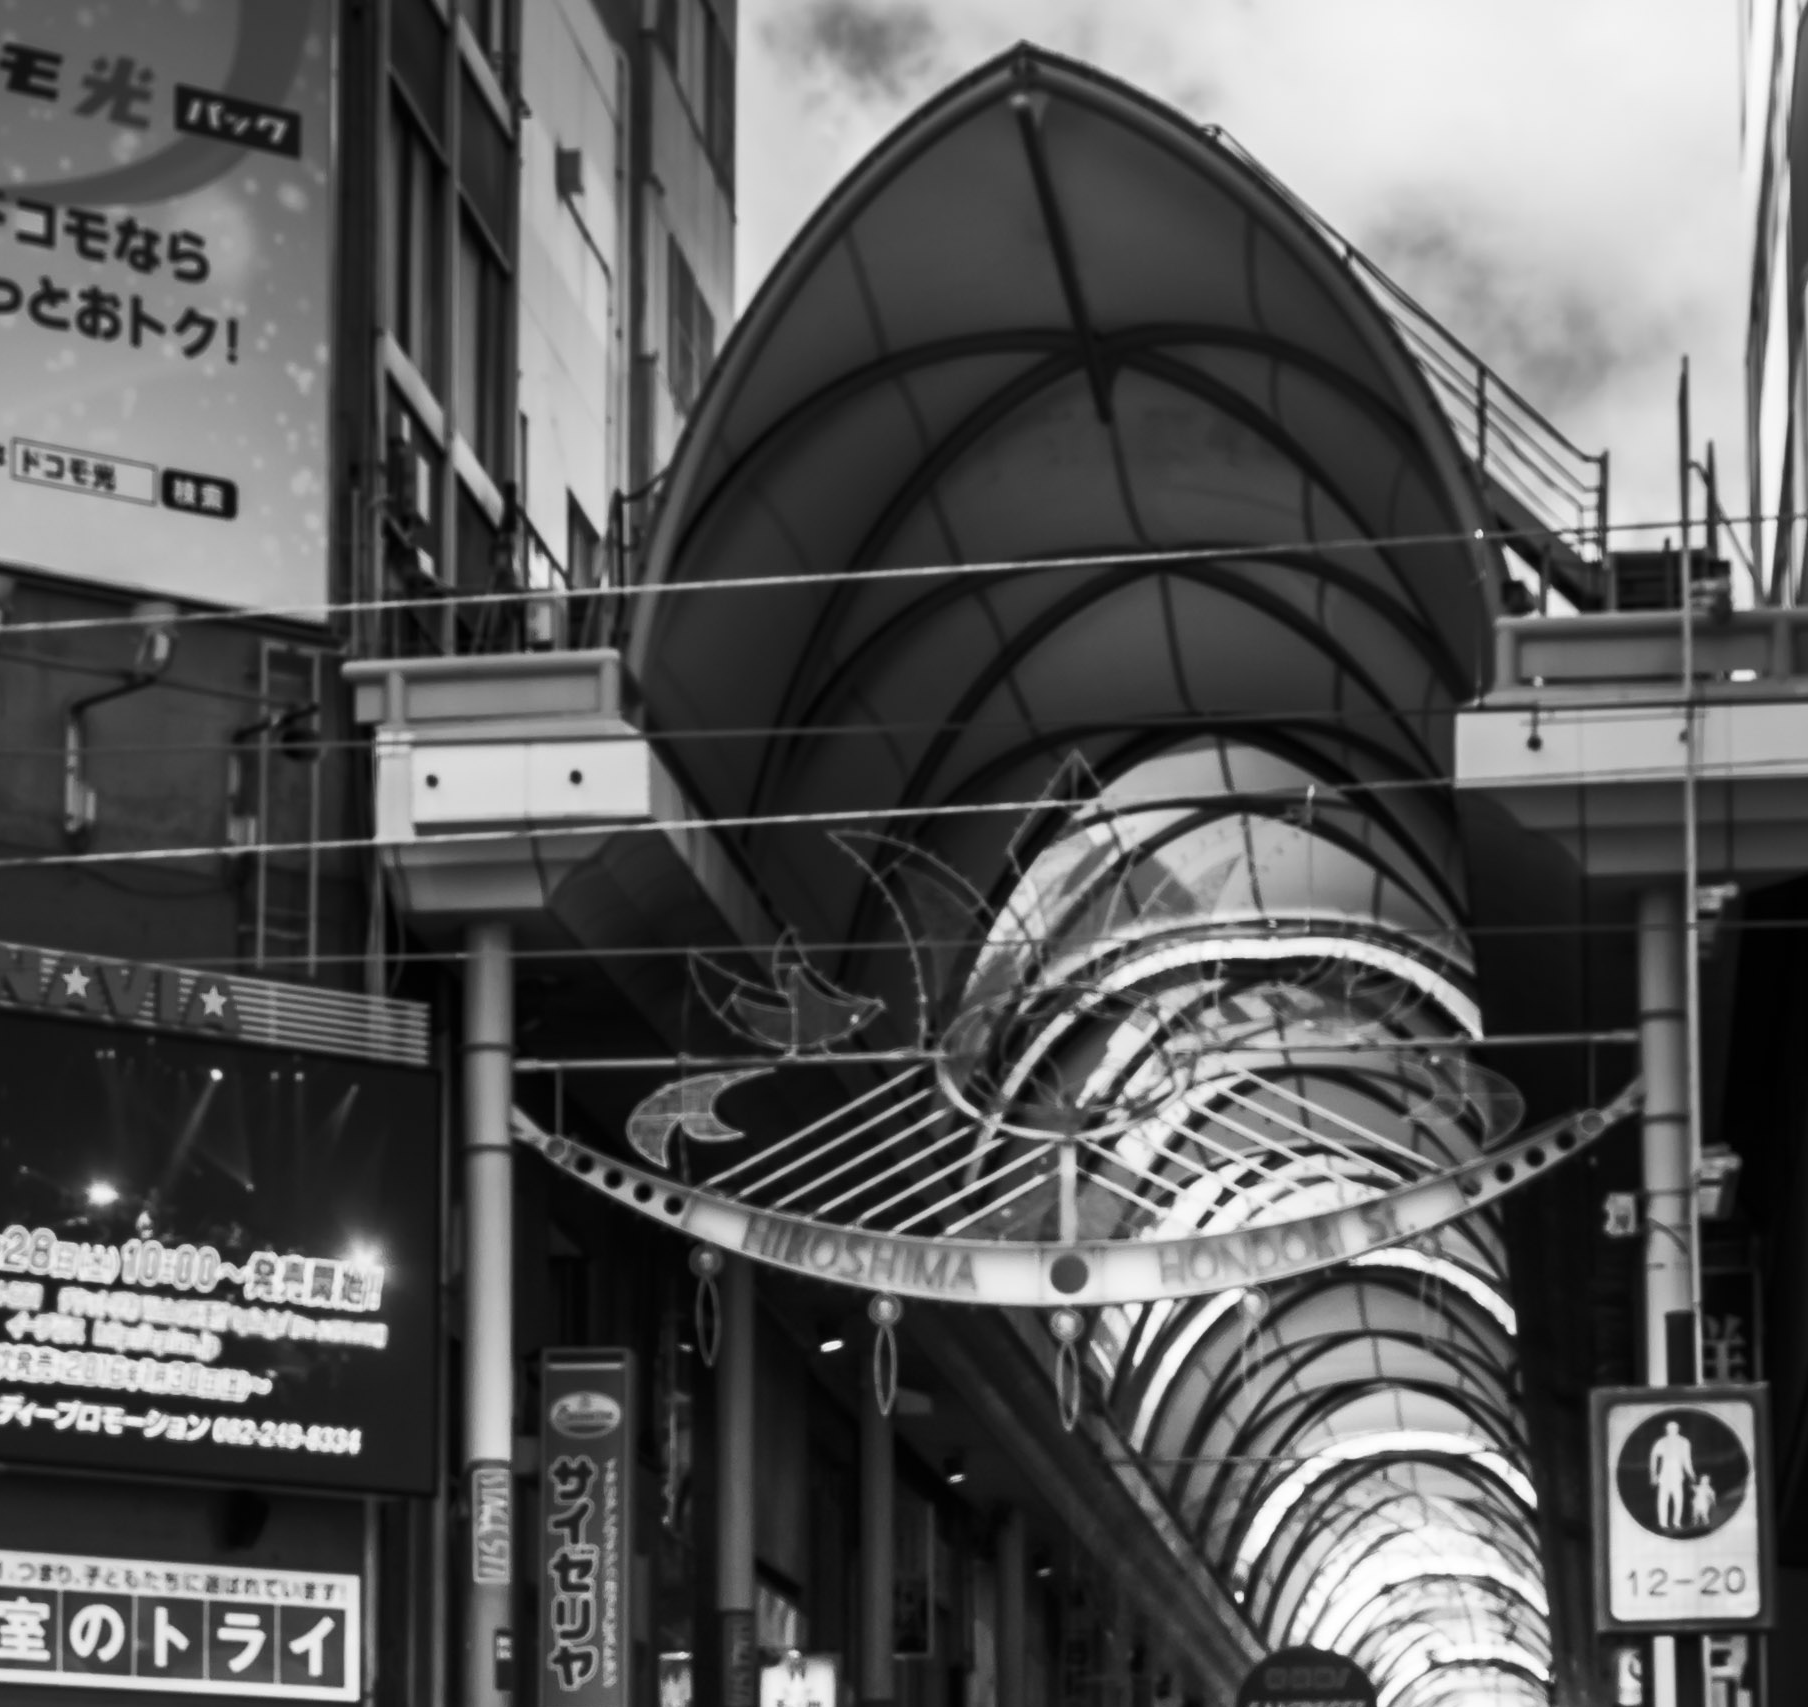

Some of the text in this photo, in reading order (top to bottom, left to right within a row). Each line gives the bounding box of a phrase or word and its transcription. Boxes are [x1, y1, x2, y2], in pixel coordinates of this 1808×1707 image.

[548, 1455, 599, 1692] サイゼリヤ
[1625, 1565, 1747, 1598] 12-20
